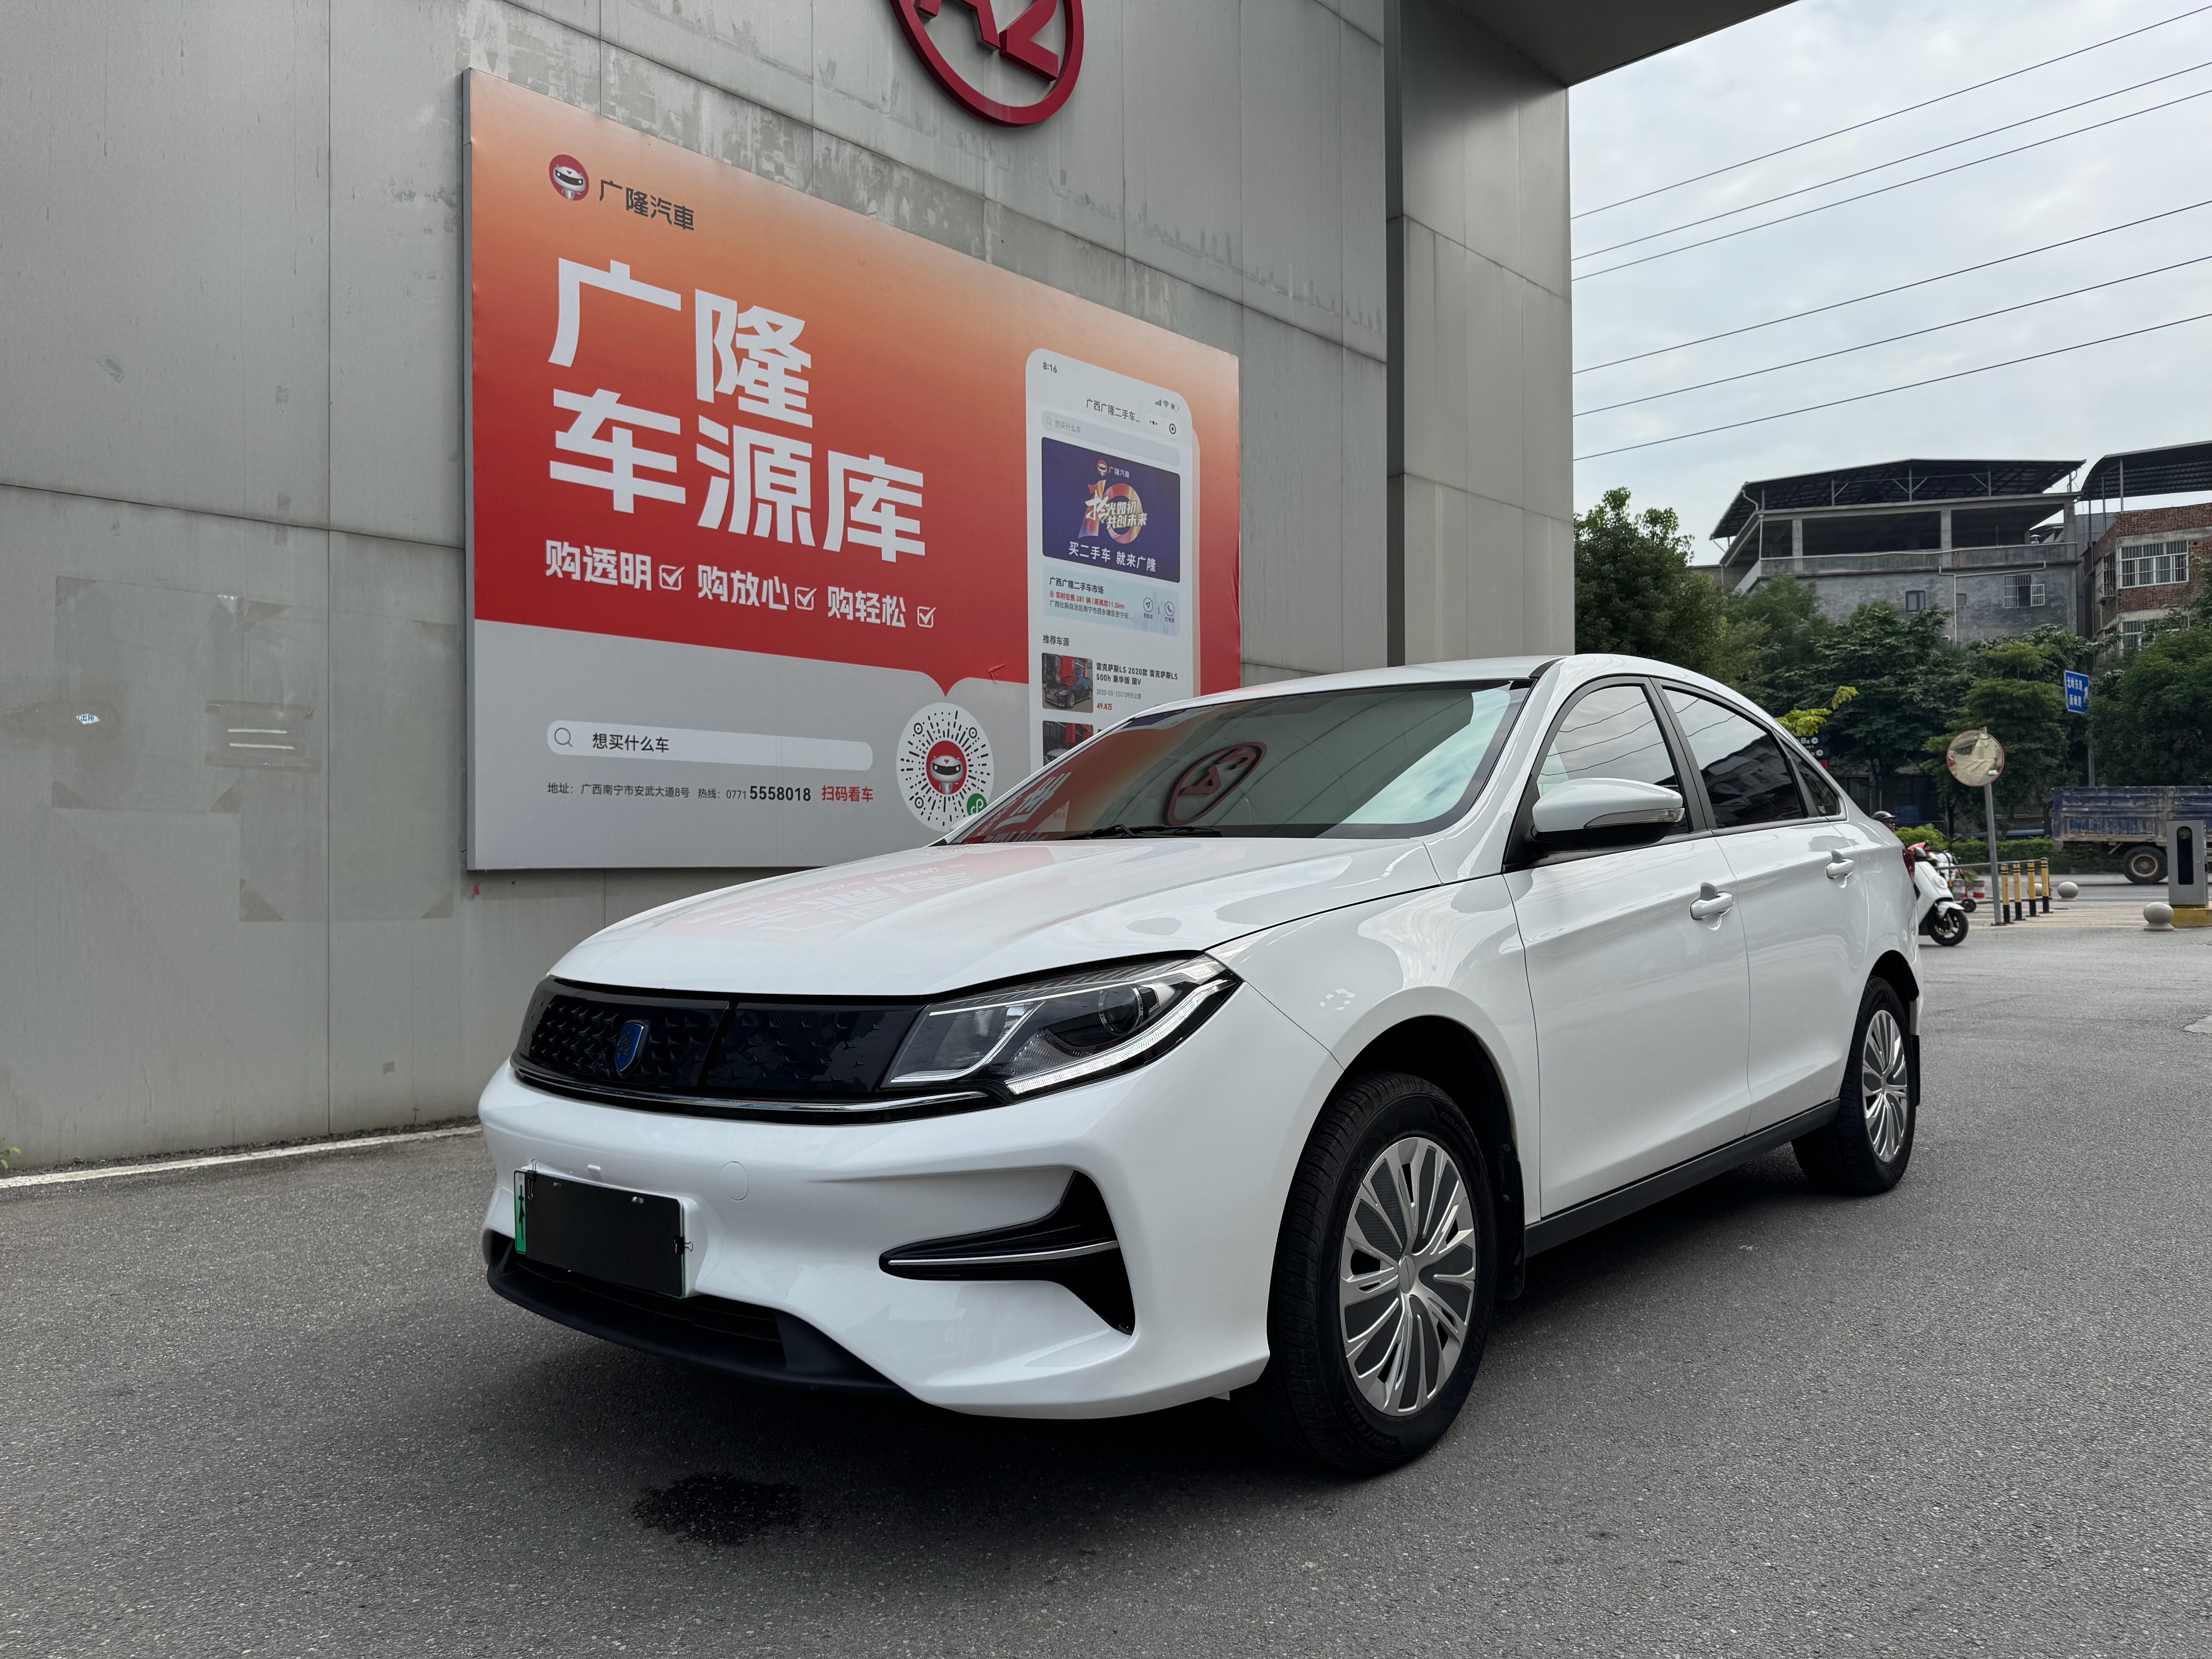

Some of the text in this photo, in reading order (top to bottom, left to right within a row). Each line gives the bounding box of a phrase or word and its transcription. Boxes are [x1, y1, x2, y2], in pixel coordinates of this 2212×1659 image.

[599, 179, 695, 231] 广隆汽車
[548, 257, 813, 428] 广隆
[1043, 362, 1057, 373] 8:16
[549, 388, 926, 563] 车源库
[1106, 512, 1147, 529] 共创未来
[1068, 541, 1156, 572] 买二手车 就来广隆
[545, 539, 906, 628] 购透明 购放心 购轻松
[1049, 577, 1104, 594] 广西广隆二手车市场
[1043, 634, 1070, 647] 推荐车源
[1096, 663, 1178, 680] 雷克萨斯LS 2020款 雷克萨斯LS
[1113, 675, 1130, 684] 豪华版
[592, 732, 670, 754] 想买什么车
[581, 783, 690, 799] 广西南宁市安武大道8号
[726, 789, 746, 800] 0771
[750, 785, 811, 802] 5558018
[821, 785, 873, 803] 扫码看车
